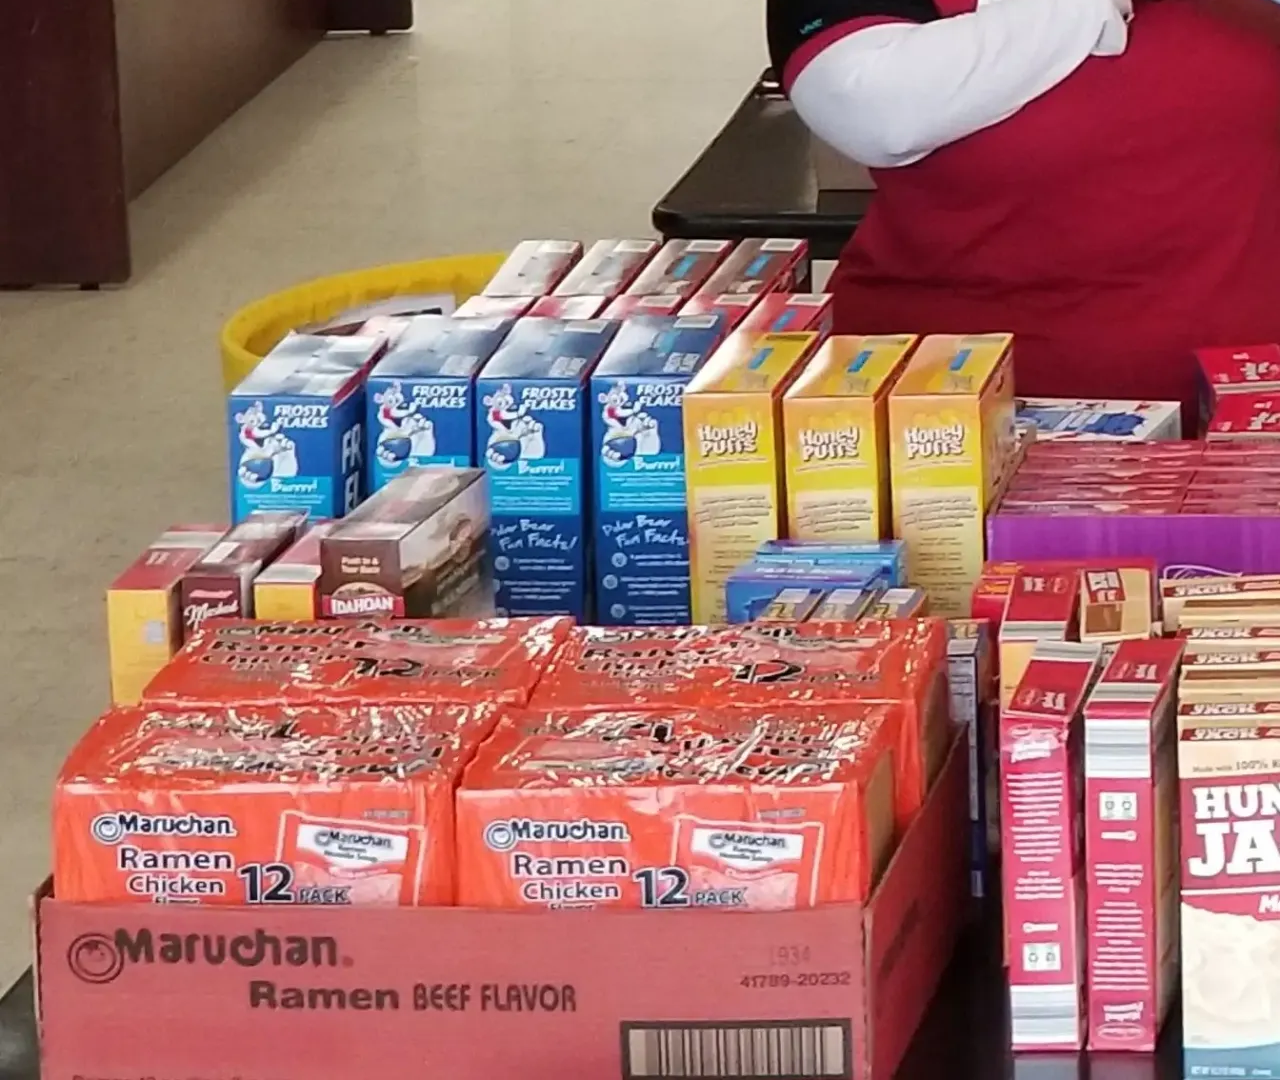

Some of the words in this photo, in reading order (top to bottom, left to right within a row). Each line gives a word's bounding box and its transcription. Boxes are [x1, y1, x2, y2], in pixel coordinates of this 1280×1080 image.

[412, 385, 468, 397] FROSTY
[521, 387, 578, 399] FROSTY
[274, 405, 330, 416] FROSTY
[413, 397, 466, 408] FLAKES
[523, 399, 576, 411] FLAKES
[275, 416, 328, 428] FLAKES
[697, 421, 758, 445] Honey
[799, 425, 860, 451] Honey
[904, 423, 965, 449] Honey
[519, 519, 555, 532] Bear
[635, 515, 672, 528] Bear
[528, 532, 579, 552] Facts!
[331, 597, 394, 615] IDAHOAN
[1236, 760, 1269, 771] 100%
[119, 813, 236, 837] Maruchan
[512, 819, 631, 841] Maruchan
[329, 831, 394, 849] Maruchan
[724, 832, 786, 849] Maruchan
[119, 848, 234, 870] Ramen
[512, 854, 628, 877] Ramen
[129, 875, 225, 897] Chicken
[238, 863, 293, 904] 12
[298, 886, 350, 904] PACK
[523, 880, 620, 901] Chicken
[633, 866, 691, 906] 12
[694, 887, 745, 906] PACK
[116, 927, 338, 967] Maruchan
[250, 981, 399, 1011] Ramen
[413, 983, 471, 1012] BEEF
[480, 983, 577, 1013] FLAVOR
